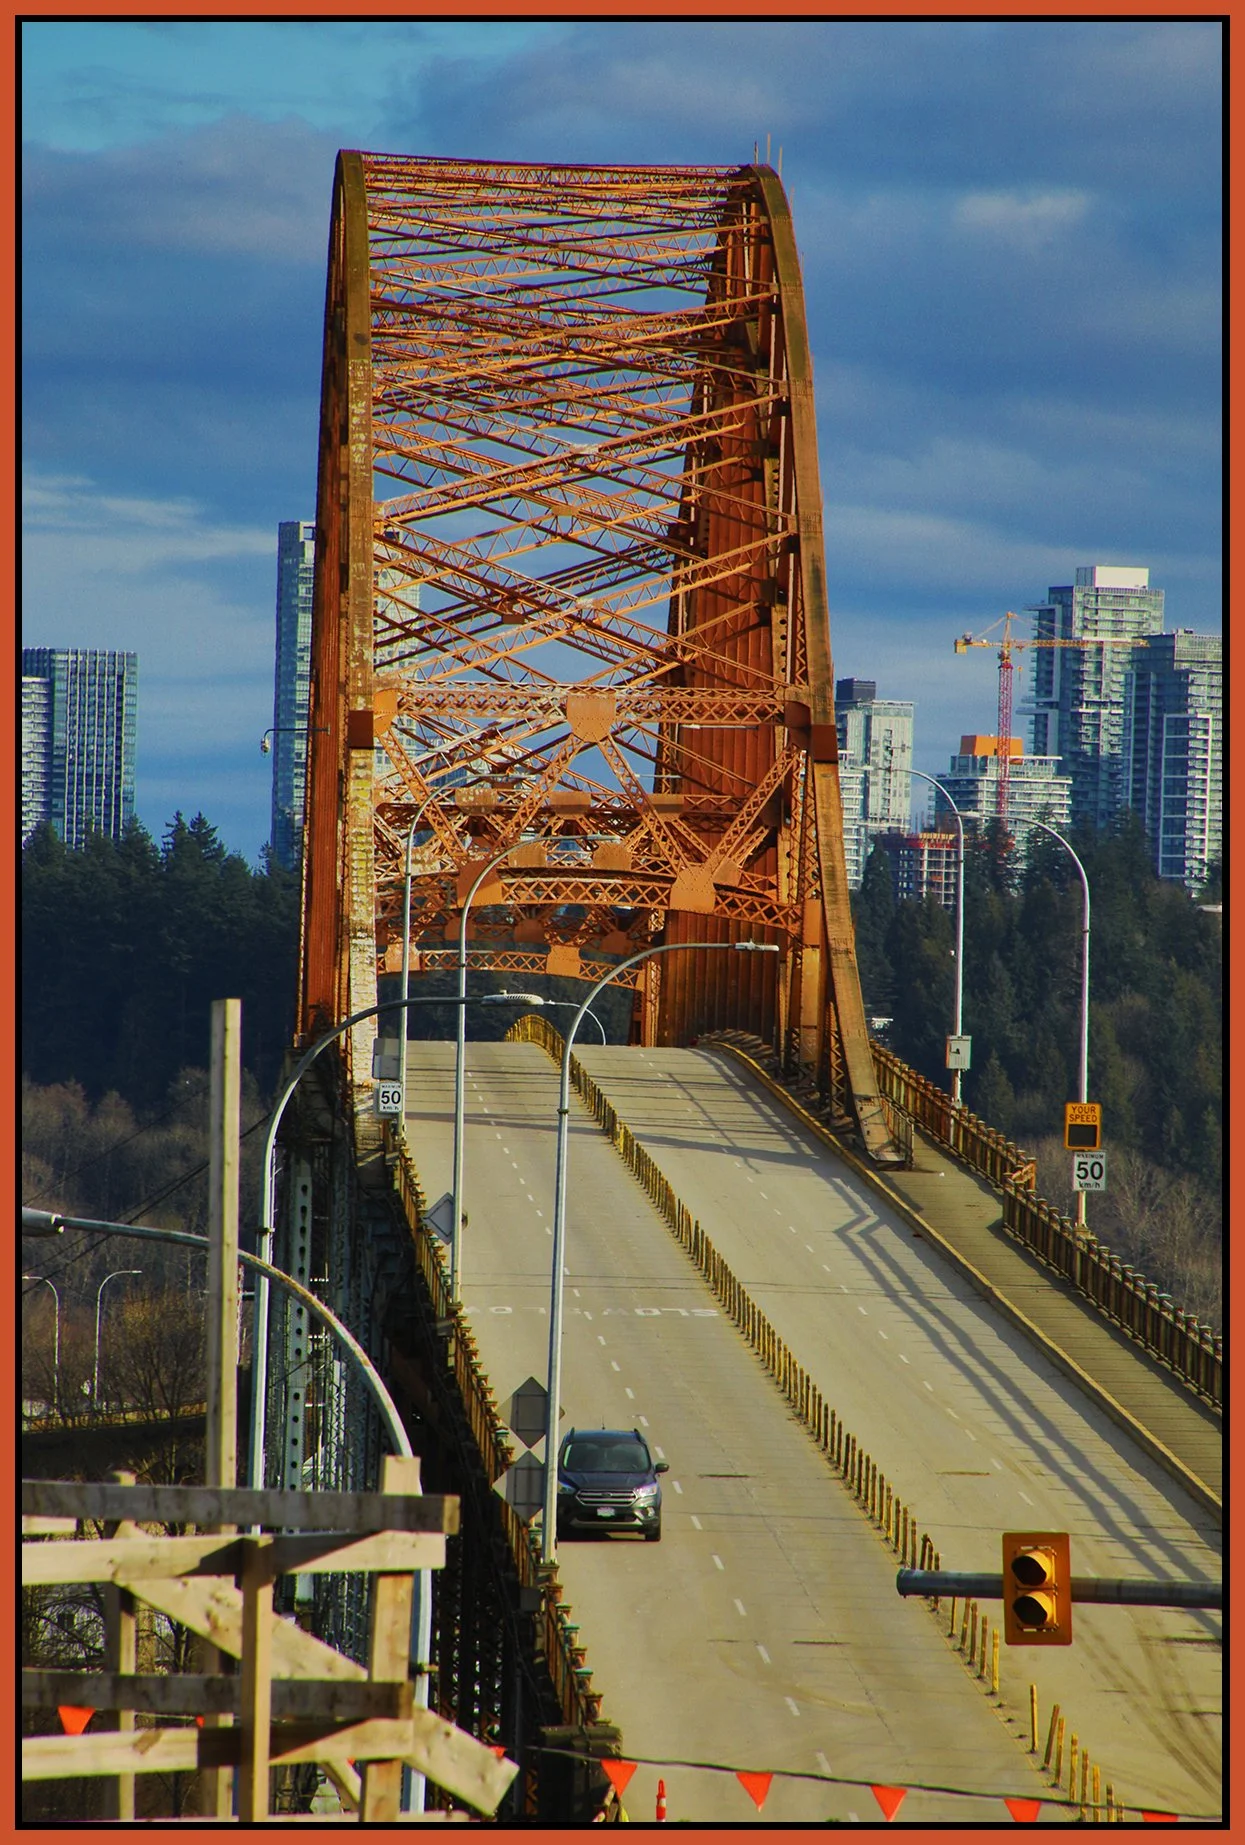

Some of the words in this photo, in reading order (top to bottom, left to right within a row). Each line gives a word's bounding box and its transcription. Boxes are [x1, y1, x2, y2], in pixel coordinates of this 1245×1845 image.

[381, 1090, 401, 1105] 50
[1071, 1105, 1097, 1114] YOUR
[1069, 1114, 1097, 1123] SPEED
[1076, 1161, 1104, 1180] 50
